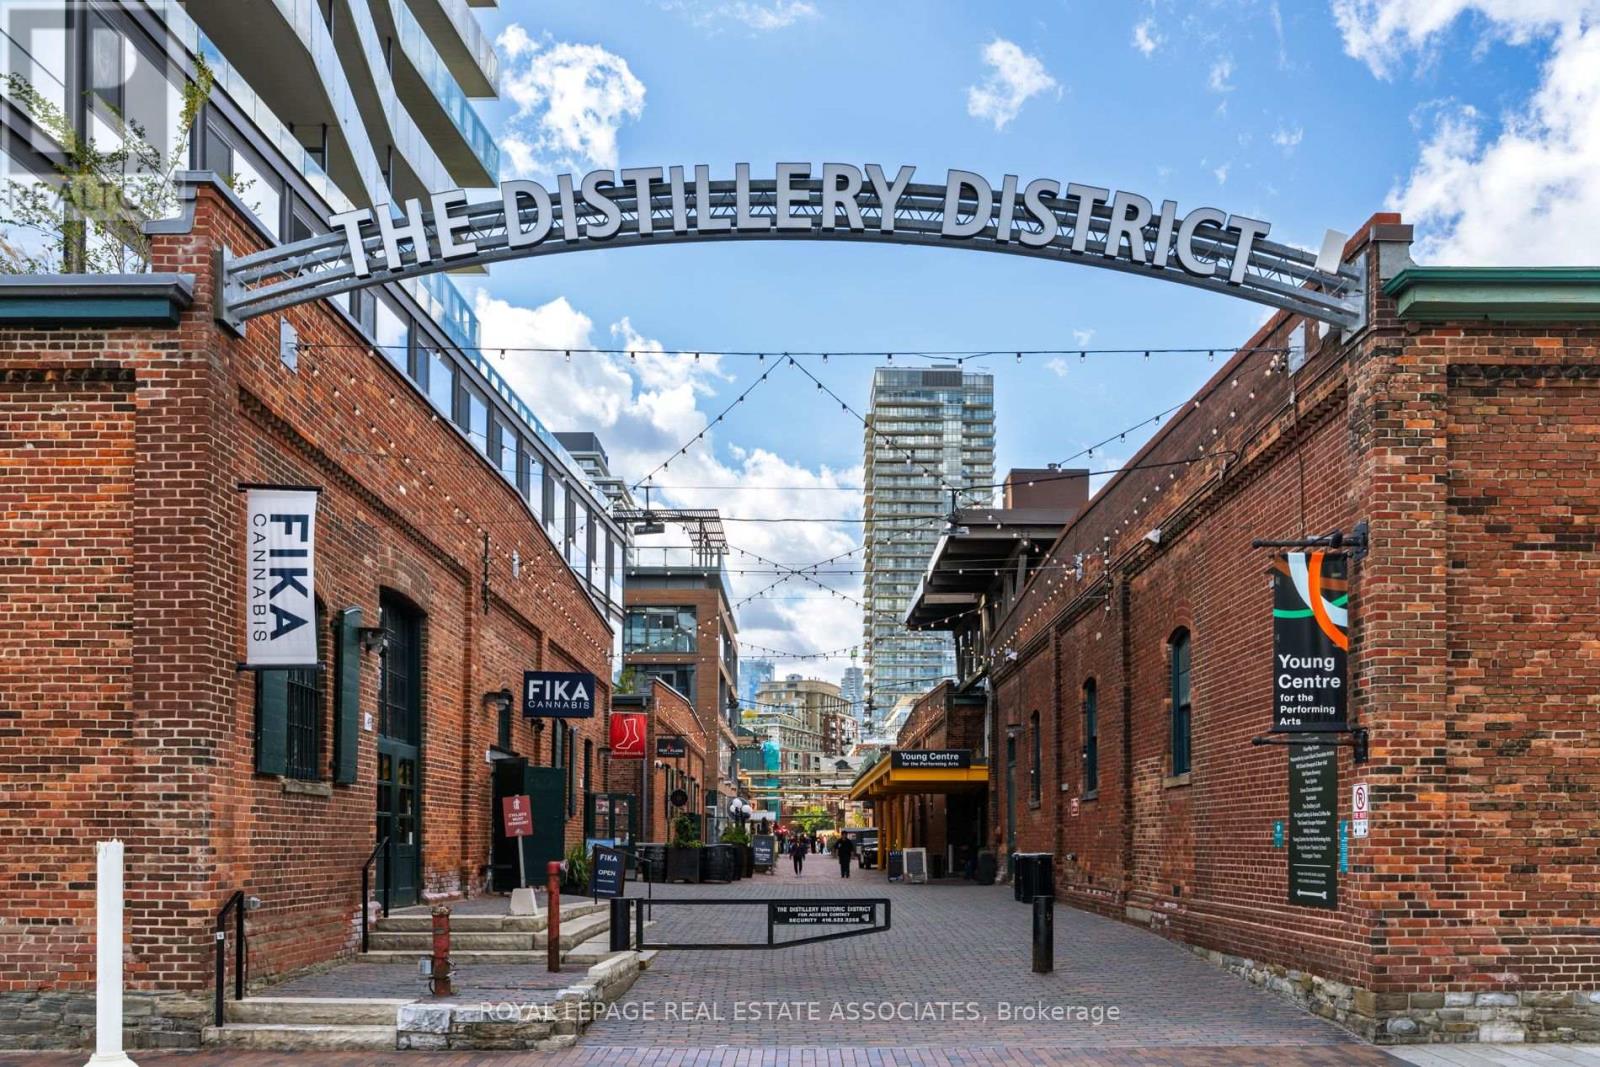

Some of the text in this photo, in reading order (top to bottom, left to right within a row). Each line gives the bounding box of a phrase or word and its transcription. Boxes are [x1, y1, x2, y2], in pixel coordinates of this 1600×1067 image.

[328, 162, 1271, 286] THE DISTILLERY DISTRICT
[253, 513, 267, 642] CANNABIS
[269, 514, 309, 640] FIKA
[1278, 654, 1335, 671] Young
[1278, 674, 1341, 689] Centre
[528, 680, 589, 701] FIKA
[1280, 693, 1314, 702] for the
[528, 700, 590, 710] CANNABIS
[1280, 705, 1336, 715] Performing
[1280, 717, 1301, 726] Arts
[900, 752, 959, 761] Young Centre
[599, 853, 618, 862] FIKA
